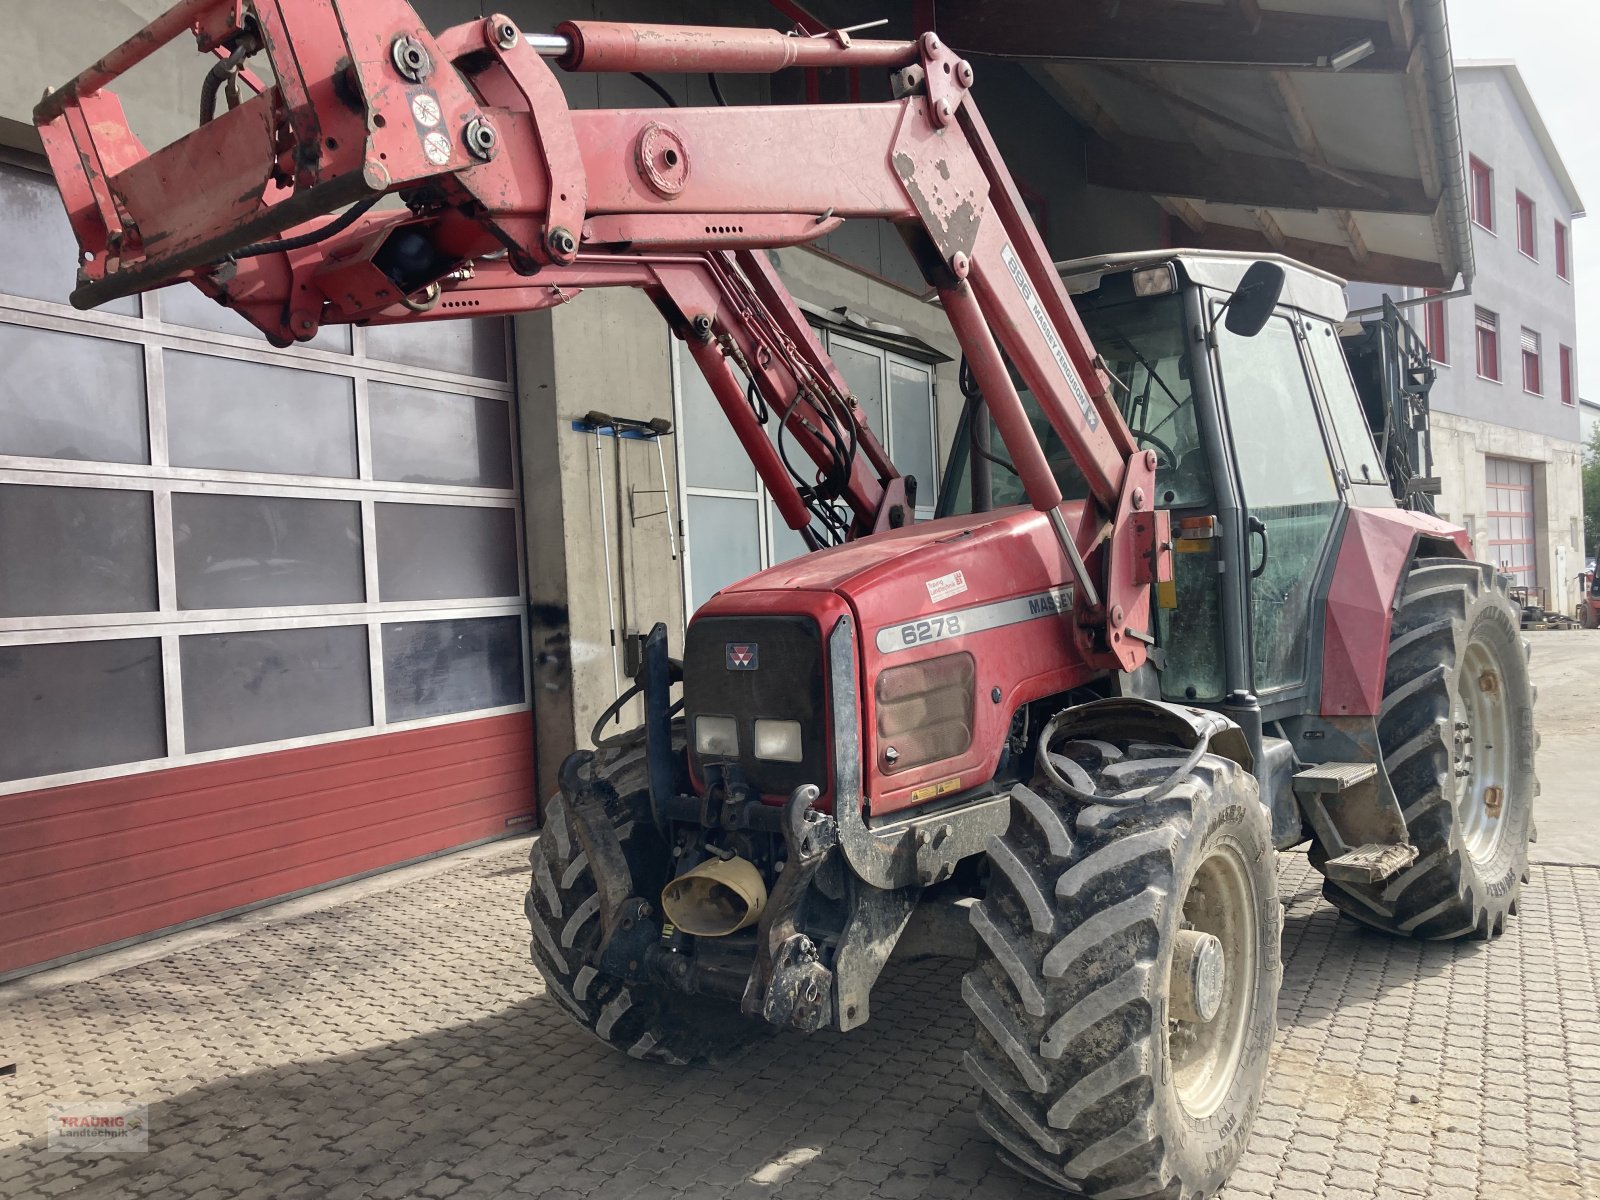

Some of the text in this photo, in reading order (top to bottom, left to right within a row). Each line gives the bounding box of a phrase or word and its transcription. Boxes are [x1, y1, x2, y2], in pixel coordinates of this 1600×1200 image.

[1007, 256, 1086, 406] 896 MASSEY FERGUSON
[1028, 591, 1073, 615] MASSEY
[901, 615, 961, 645] 6278
